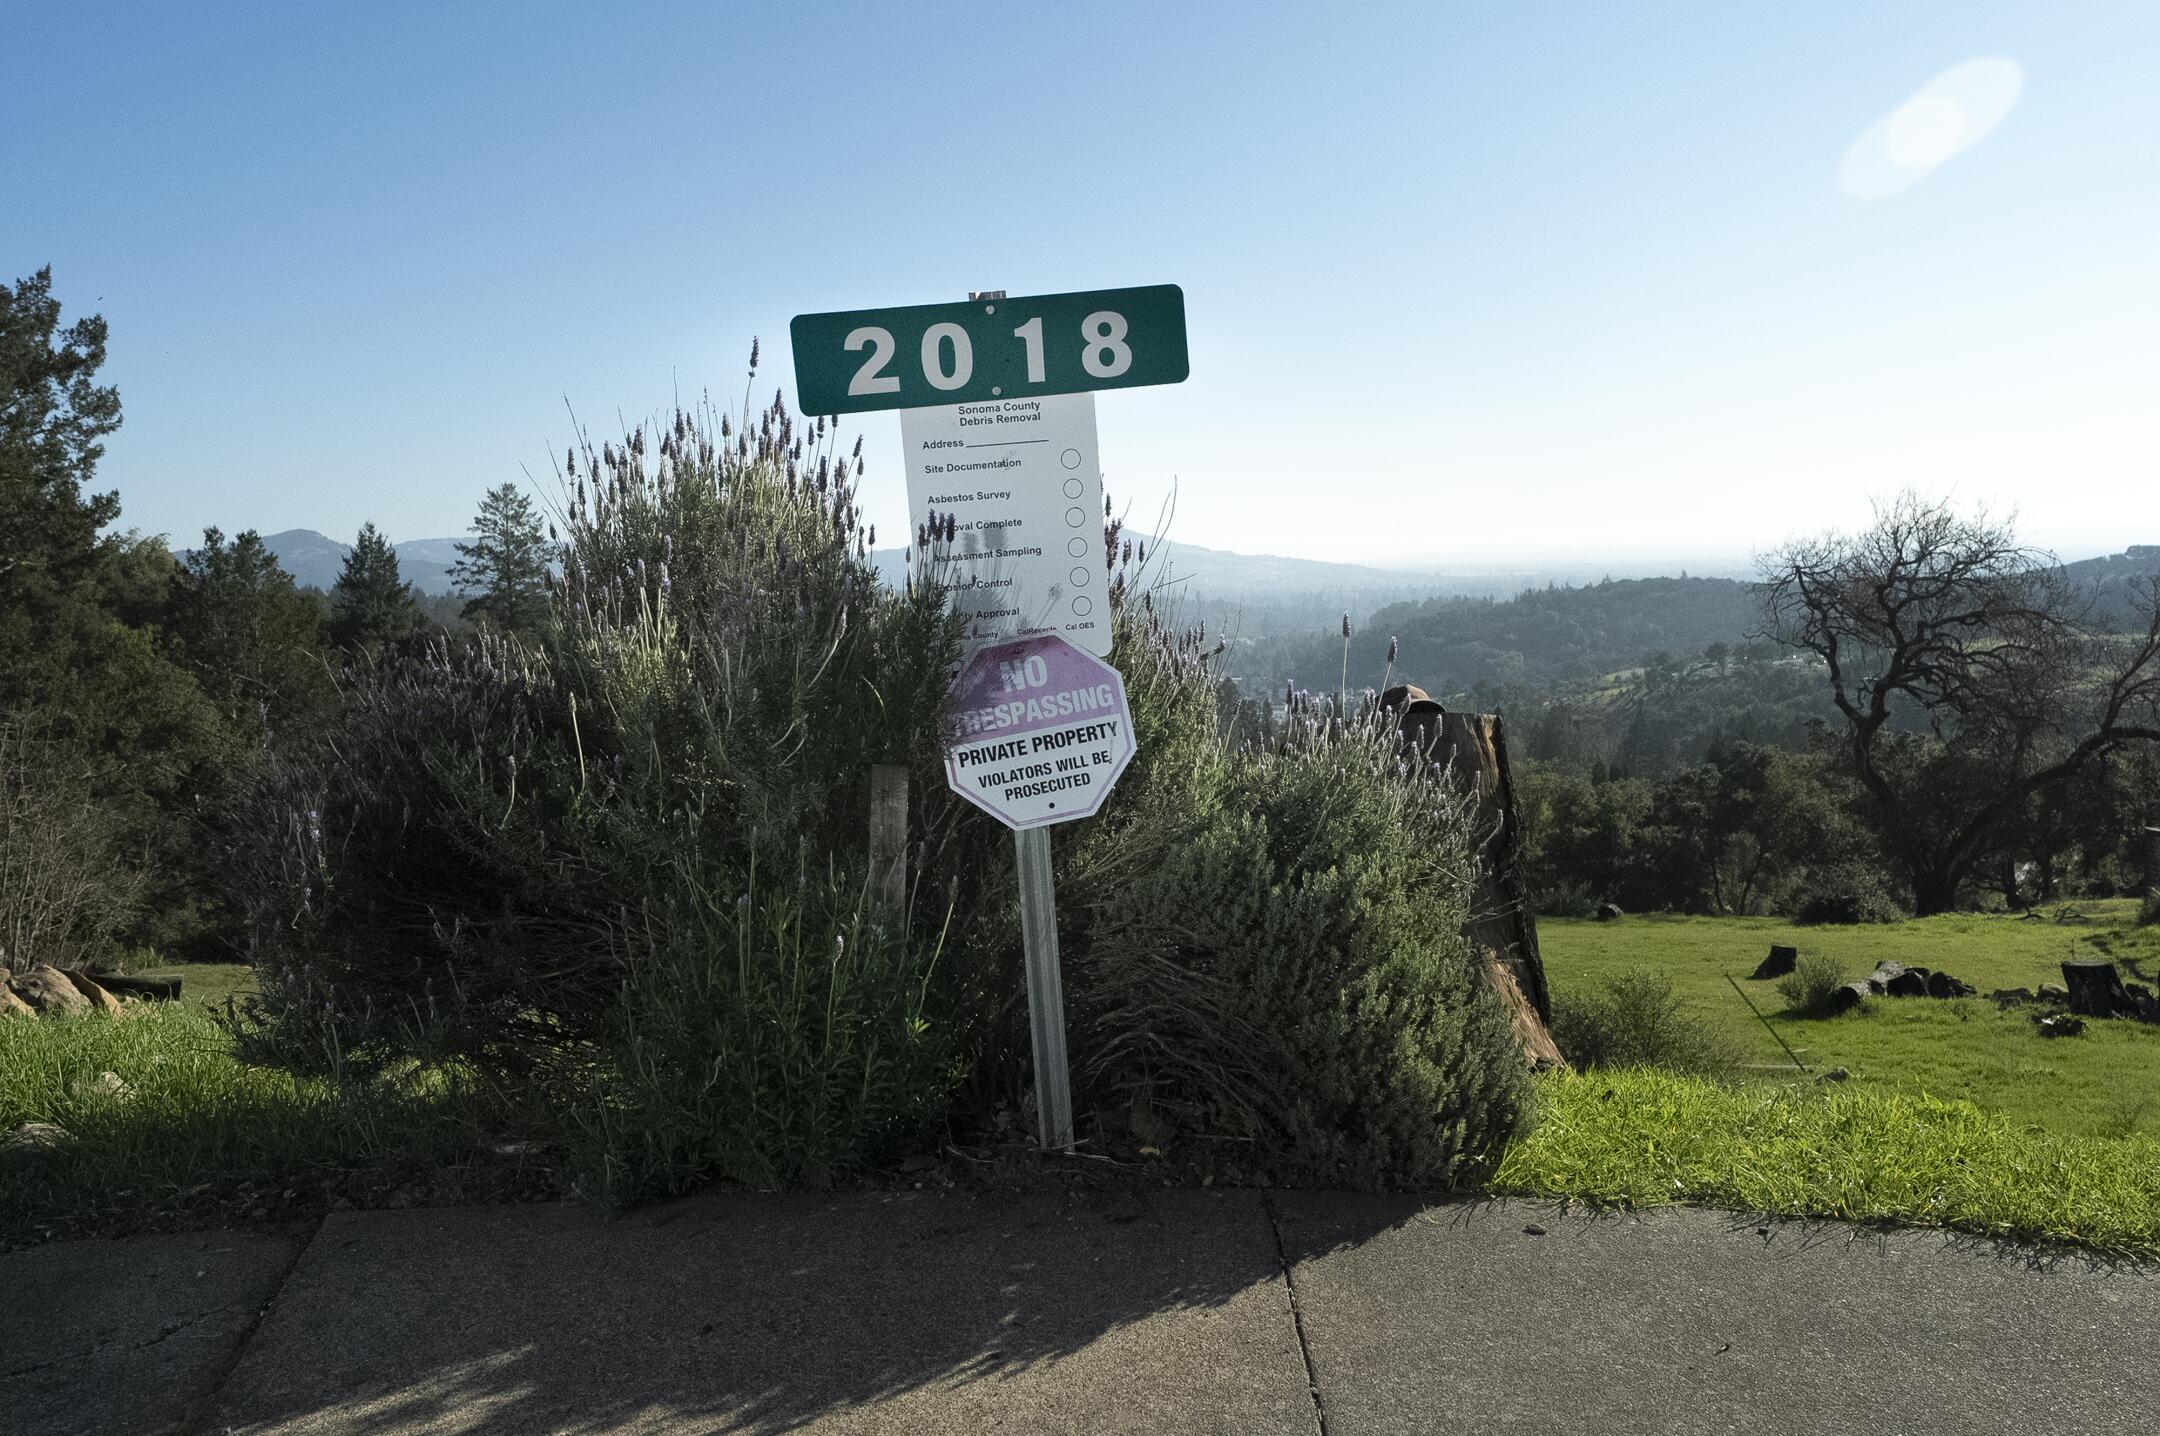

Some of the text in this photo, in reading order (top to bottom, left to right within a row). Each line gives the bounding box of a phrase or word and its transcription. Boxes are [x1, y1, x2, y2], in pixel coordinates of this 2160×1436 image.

[843, 310, 1133, 396] 2018
[958, 401, 1041, 415] Sonoma County
[959, 412, 1041, 427] Debris Removal
[922, 439, 964, 450] Address
[924, 458, 1022, 474] Site Documentation
[927, 490, 1011, 504] Asbestos Survey
[976, 518, 1023, 530] Complete
[996, 546, 1042, 558] Sampling
[976, 577, 1013, 589] Control
[976, 607, 1020, 620] Approval
[1065, 623, 1077, 631] Cal
[1079, 621, 1095, 630] OES
[1000, 655, 1048, 693] NO
[954, 684, 1115, 736] RESPASSING
[958, 721, 1118, 768] PRIVATE PROPERTY
[978, 750, 1110, 788] VIOLATORS WILL BE
[1004, 772, 1091, 801] PROSECUTED
